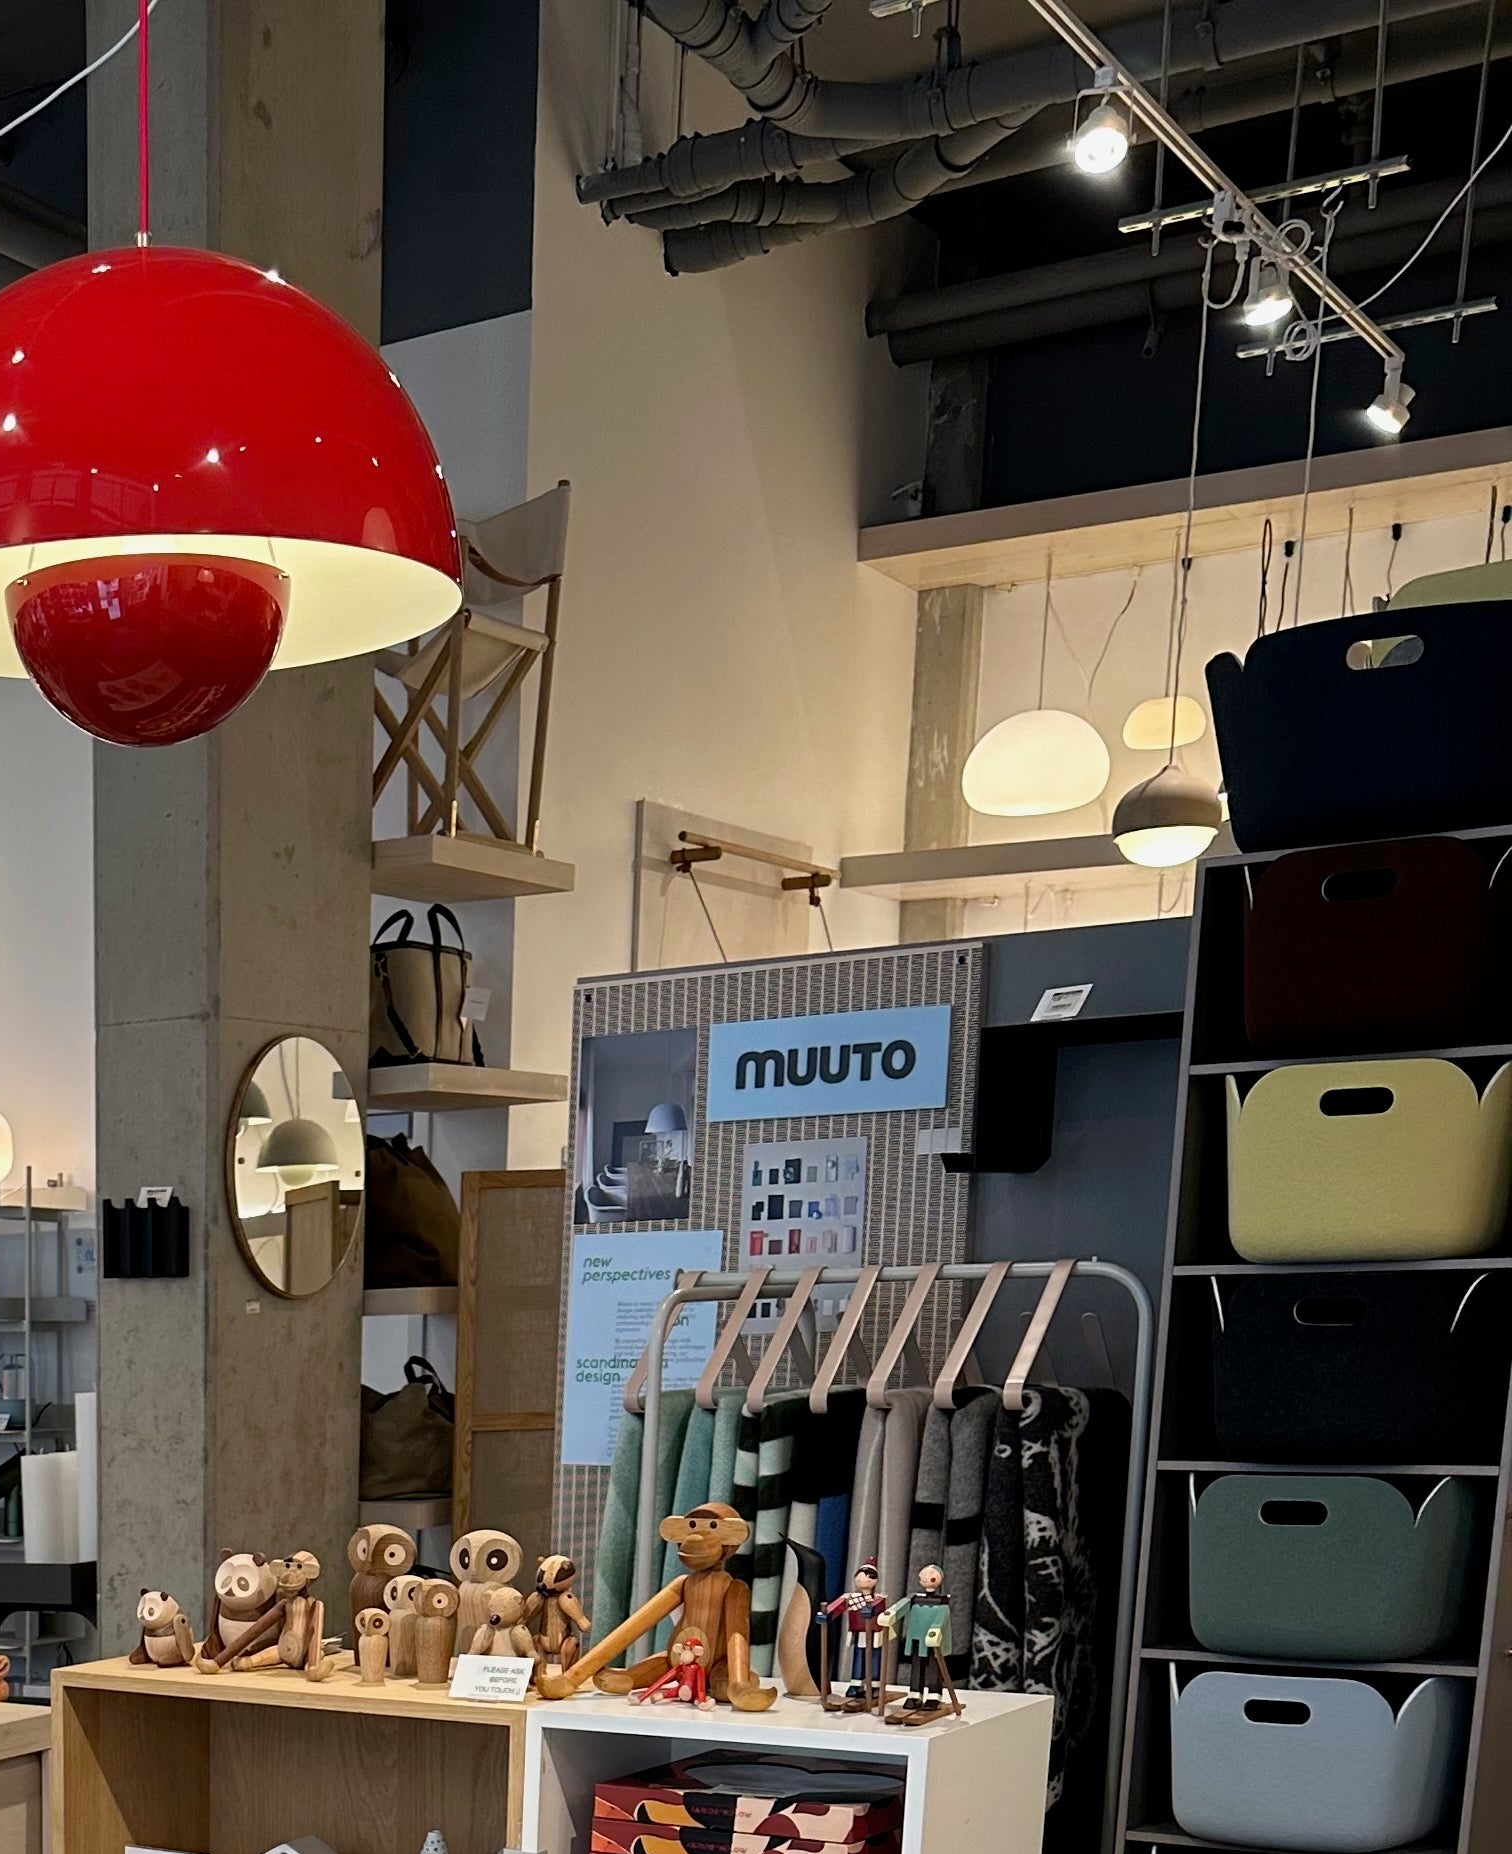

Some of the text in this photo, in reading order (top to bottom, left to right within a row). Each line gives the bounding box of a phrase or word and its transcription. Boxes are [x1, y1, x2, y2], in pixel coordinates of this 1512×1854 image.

[735, 1039, 917, 1091] MUUTO
[583, 1257, 614, 1268] new
[581, 1267, 672, 1285] perspectives
[576, 1369, 622, 1386] design
